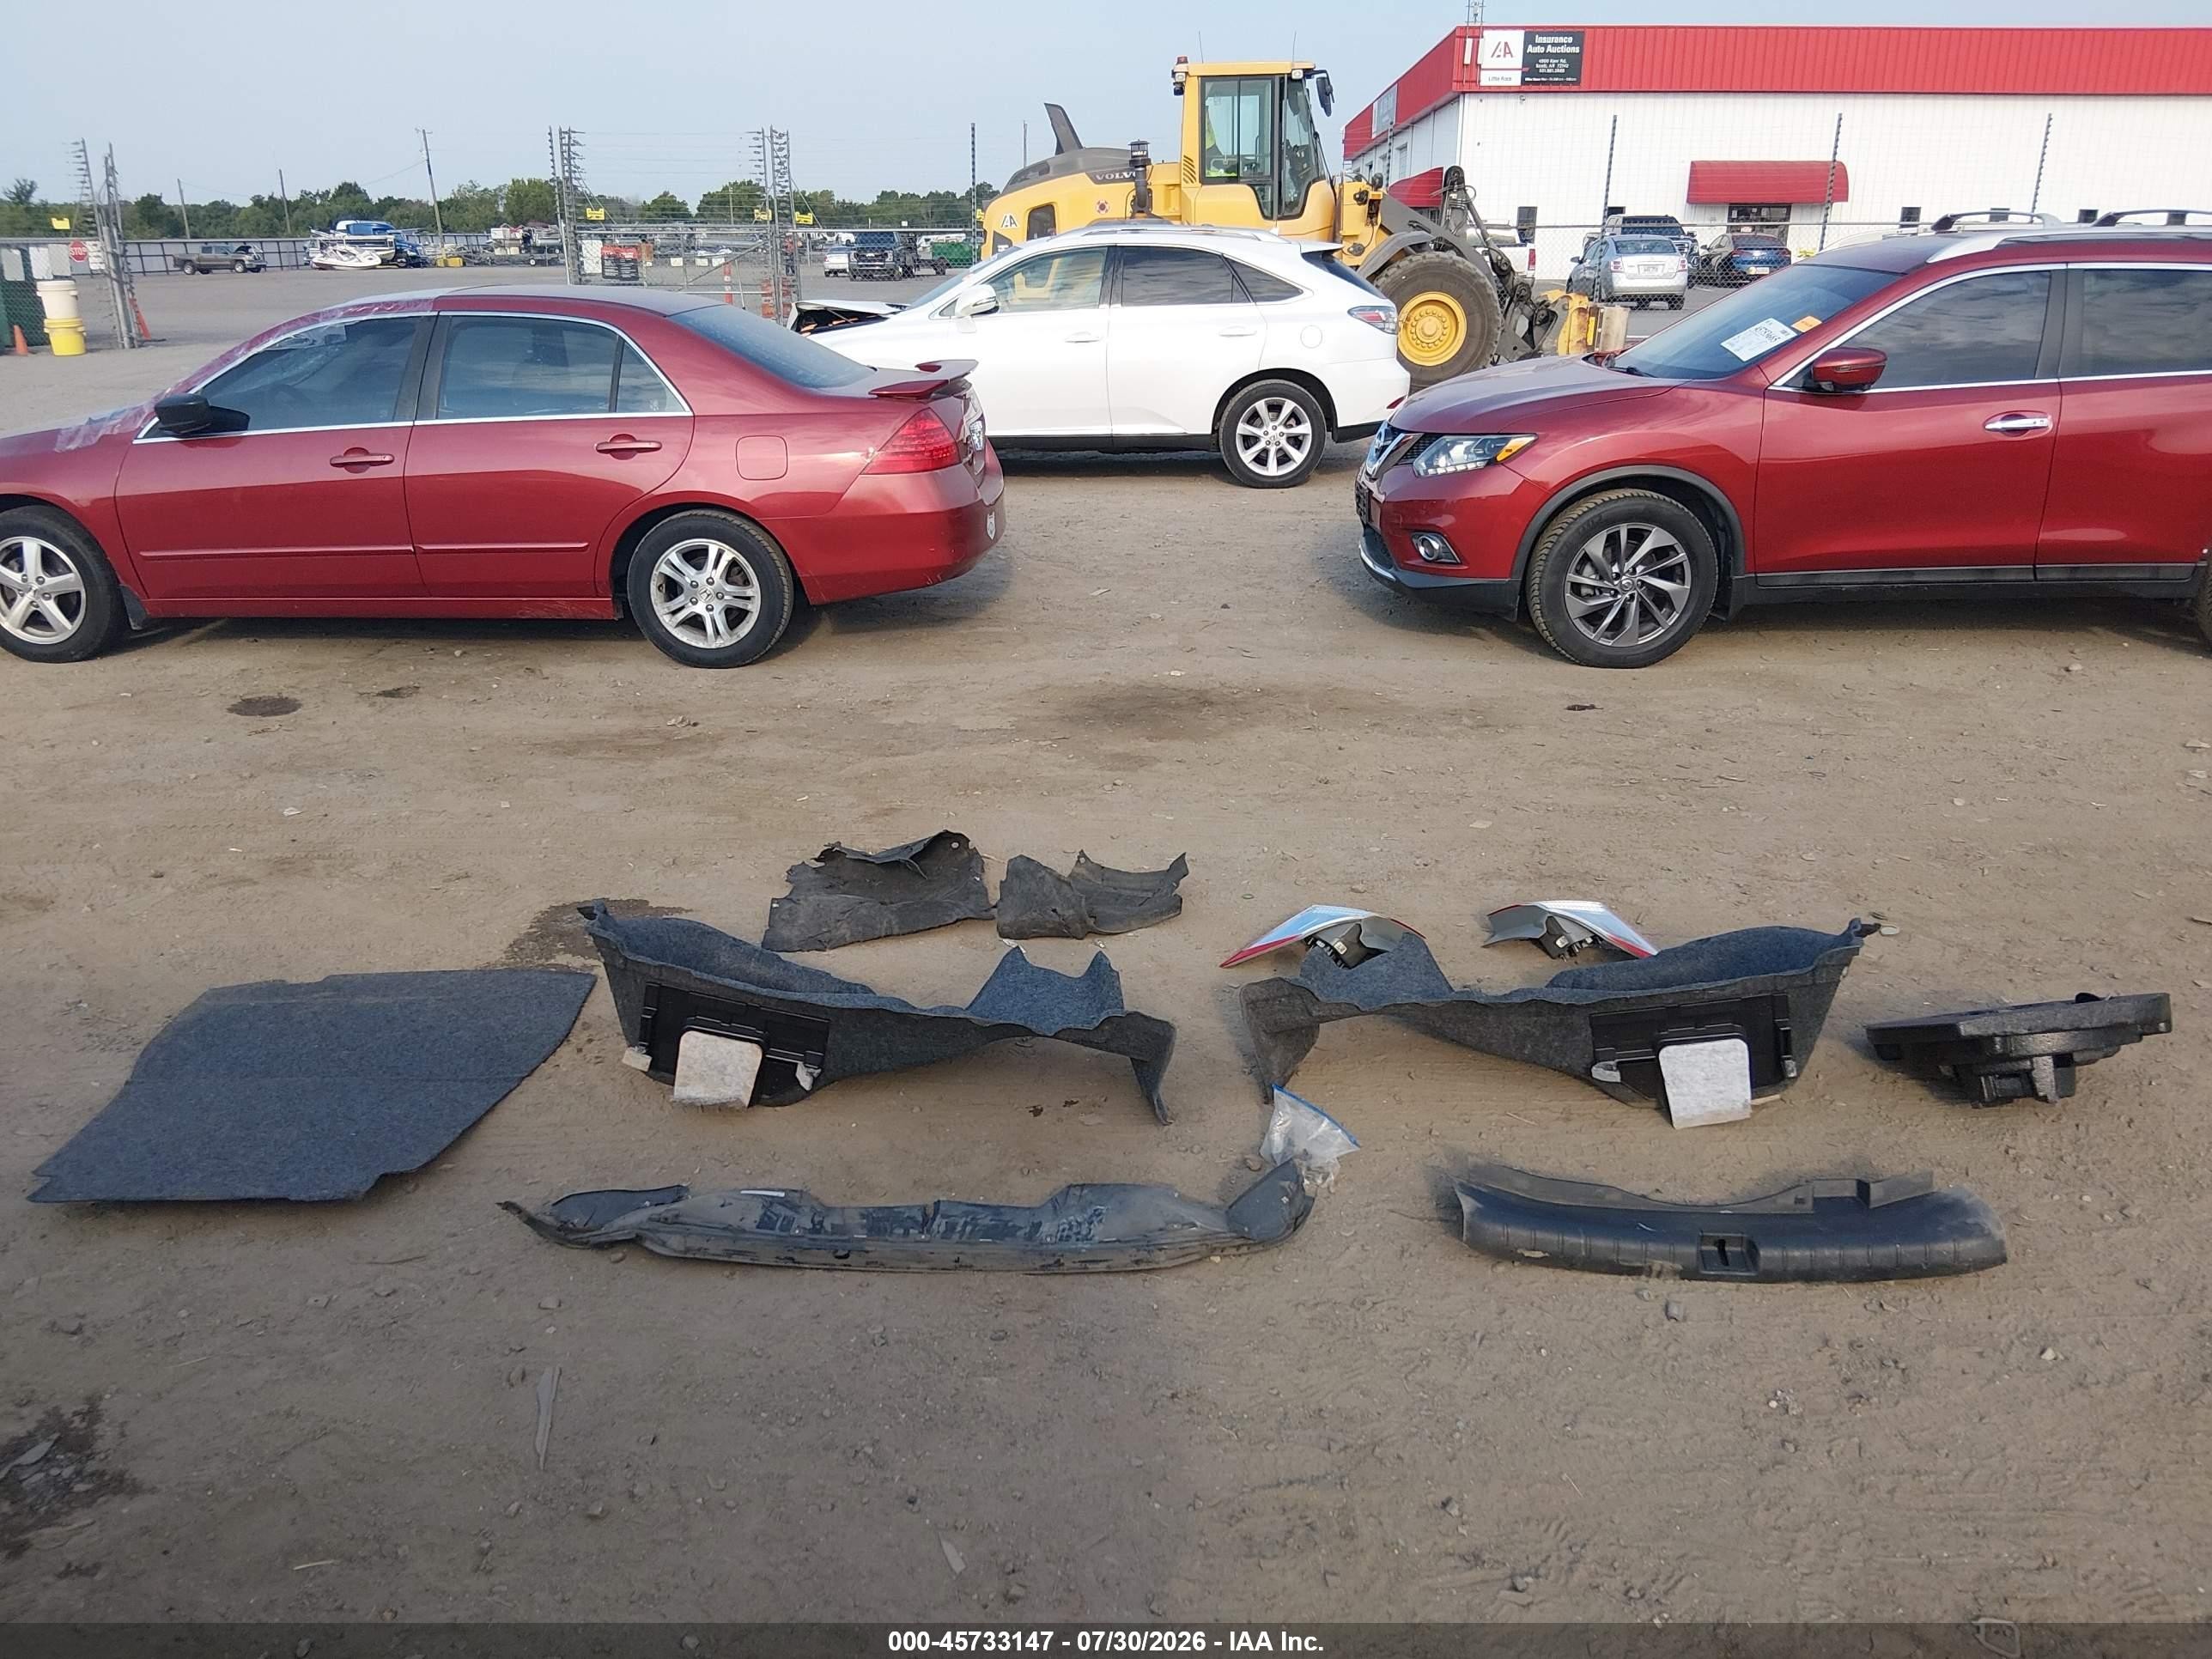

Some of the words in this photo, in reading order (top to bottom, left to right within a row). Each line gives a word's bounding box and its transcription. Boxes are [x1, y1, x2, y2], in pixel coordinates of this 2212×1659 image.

[1534, 34, 1573, 44] Insurance
[1526, 44, 1546, 53] Auto
[1546, 44, 1580, 53] Auctions
[1096, 171, 1136, 180] VOLV
[70, 246, 88, 256] STOP
